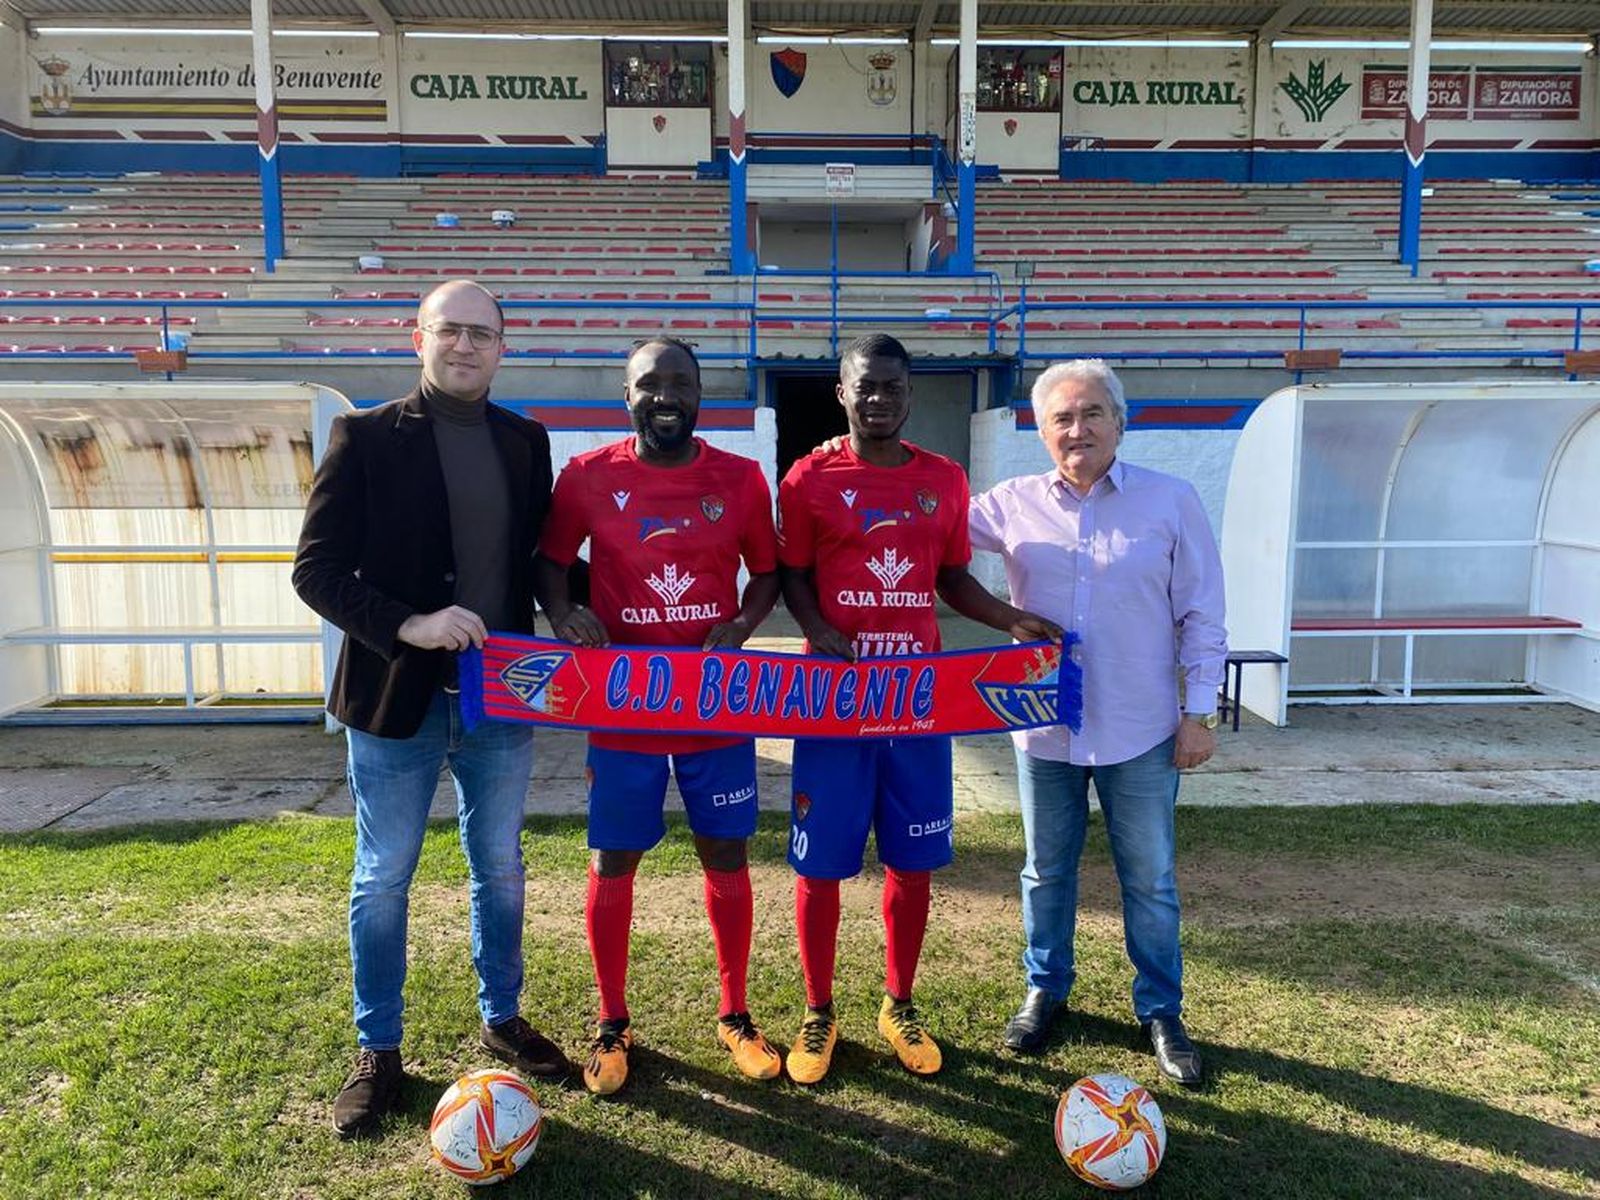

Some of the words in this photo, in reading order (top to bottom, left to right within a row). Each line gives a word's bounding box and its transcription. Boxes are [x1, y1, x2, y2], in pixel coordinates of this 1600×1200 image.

[77, 62, 230, 92] Ayuntamiento
[274, 64, 382, 89] Benavente
[410, 74, 481, 101] CAJA
[486, 75, 588, 100] RURAL
[1073, 80, 1140, 107] CAJA
[1145, 81, 1242, 105] RURAL
[1387, 90, 1462, 105] ZAORA
[1499, 90, 1573, 106] ZAMORA
[837, 590, 878, 608] CAJA
[881, 592, 932, 608] RURAL
[621, 607, 662, 625] CAJA
[665, 602, 721, 622] RURAL
[606, 654, 683, 713] C.D.
[697, 655, 936, 721] BENAVENTE
